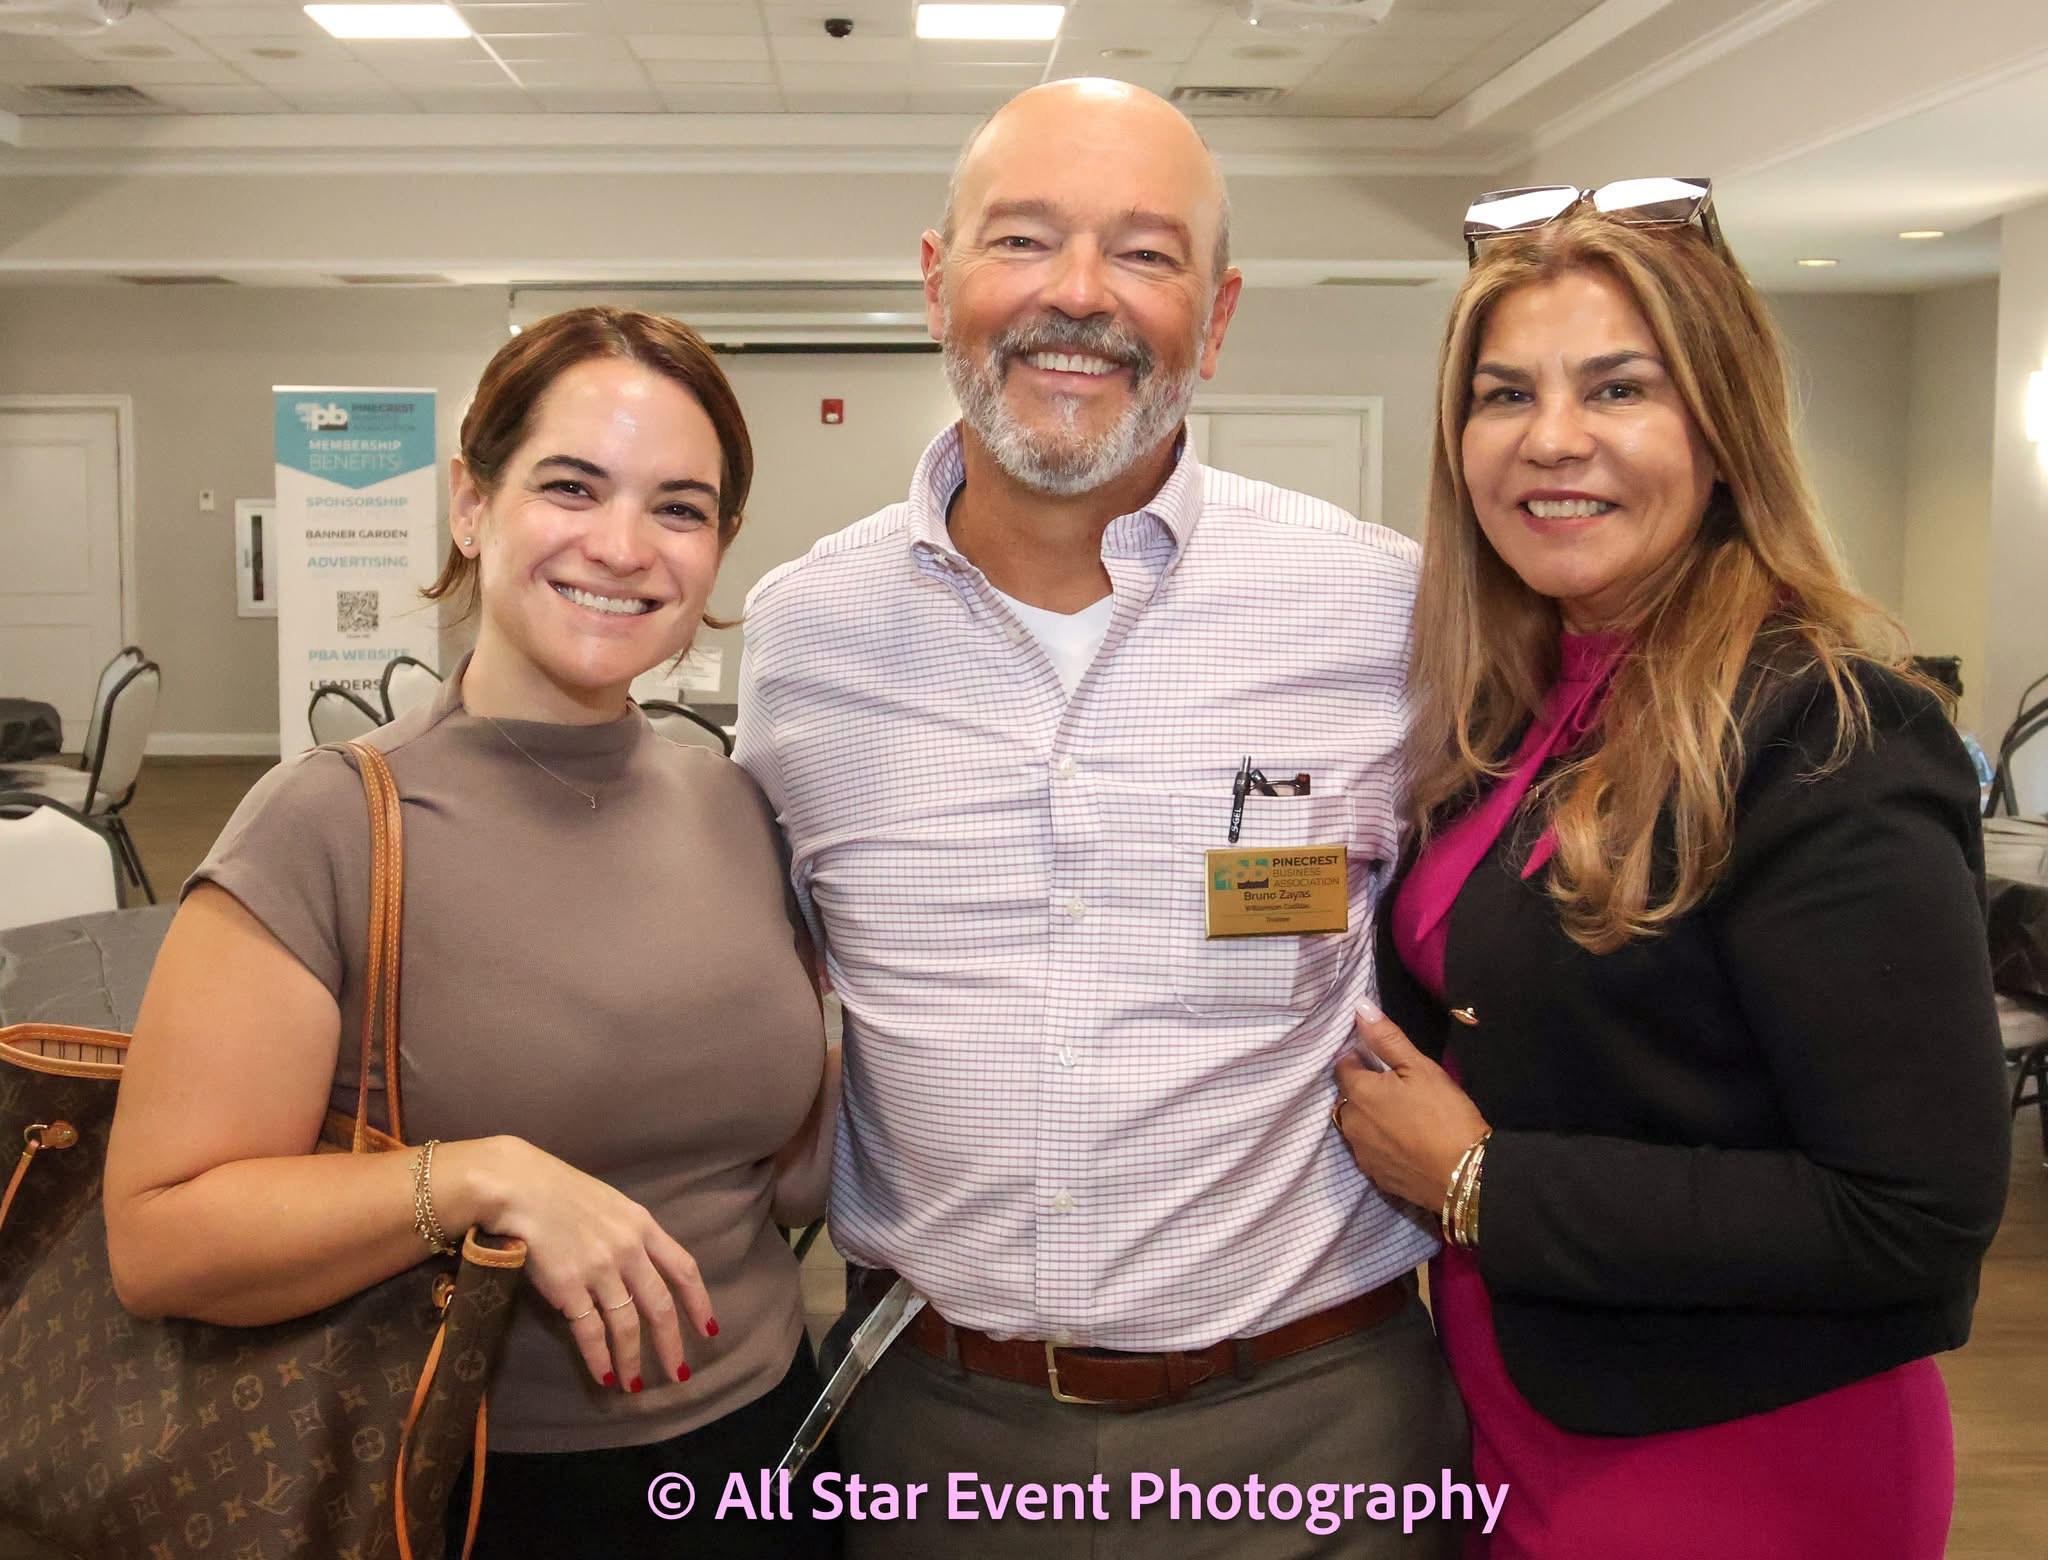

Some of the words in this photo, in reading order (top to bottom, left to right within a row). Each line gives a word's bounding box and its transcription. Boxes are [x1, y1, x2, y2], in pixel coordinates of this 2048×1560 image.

[308, 439, 401, 450] MEMBERSHIP
[309, 453, 401, 471] BENEFITS
[305, 496, 408, 507] SPONSORSHIP
[304, 529, 356, 539] BANNER
[358, 529, 409, 539] GARDEN
[307, 556, 409, 569] ADVERTISING
[308, 648, 339, 661] PBA
[342, 648, 409, 661] WEBSITE
[1272, 856, 1339, 867] PINECREST
[1273, 867, 1321, 878] BUSINESS
[1273, 876, 1340, 889] ASSOCIATION
[1244, 891, 1277, 901] Bruno
[1279, 889, 1311, 902] Zayas
